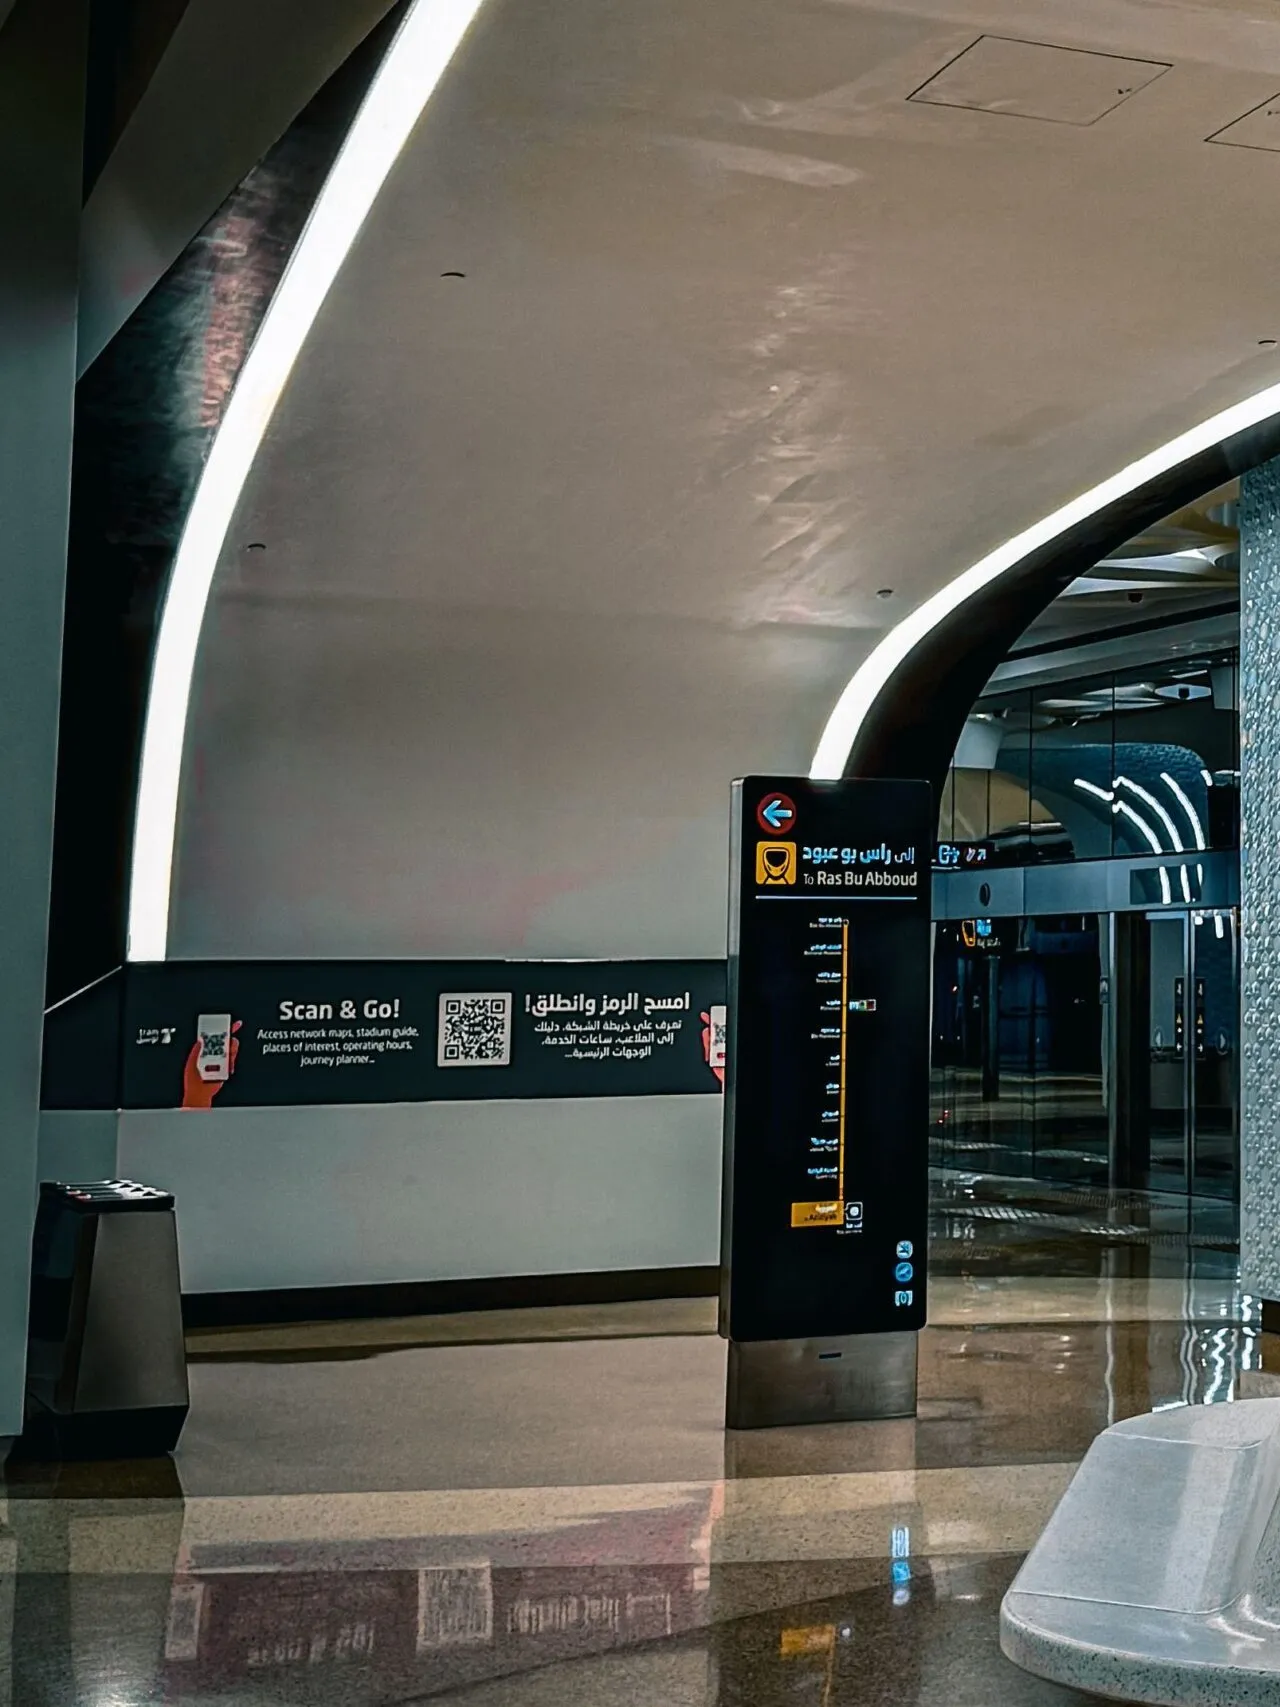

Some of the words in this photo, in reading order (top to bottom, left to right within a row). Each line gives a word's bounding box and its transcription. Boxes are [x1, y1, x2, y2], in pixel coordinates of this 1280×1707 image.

[802, 846, 838, 865] عبود
[894, 846, 915, 865] إلى
[803, 873, 814, 886] To
[817, 871, 842, 886] Ras
[844, 872, 863, 886] Bu
[865, 871, 918, 887] Abboud
[279, 1001, 333, 1021] Scan
[339, 1000, 357, 1020] &
[363, 998, 400, 1020] Go!
[525, 993, 596, 1017] وانطلق!
[600, 992, 639, 1016] الرمز
[643, 992, 690, 1015] امسح
[257, 1029, 289, 1040] Access
[290, 1028, 327, 1039] network
[356, 1026, 391, 1038] stadium
[262, 1042, 292, 1055] places
[293, 1041, 303, 1053] of
[342, 1040, 385, 1053] operating
[300, 1056, 335, 1067] journey
